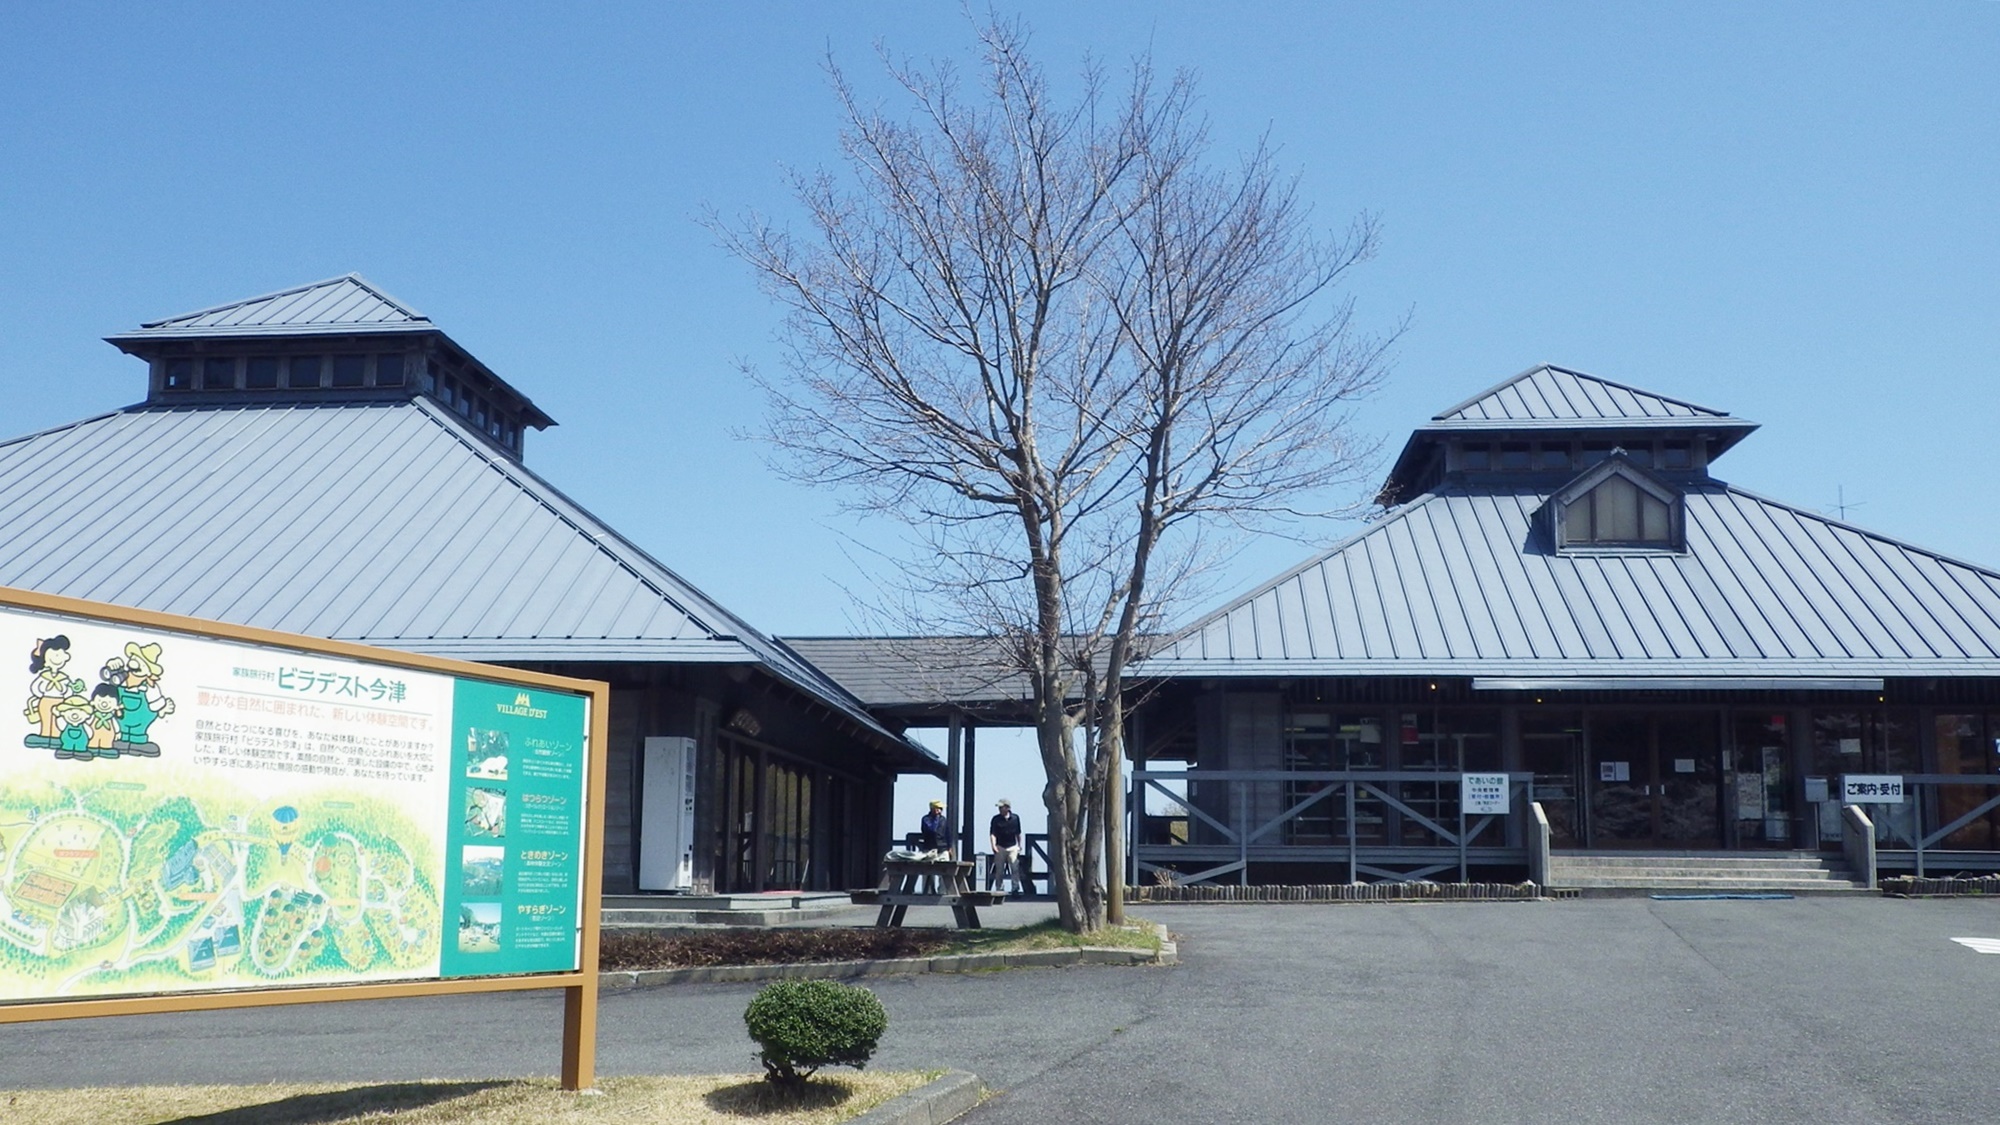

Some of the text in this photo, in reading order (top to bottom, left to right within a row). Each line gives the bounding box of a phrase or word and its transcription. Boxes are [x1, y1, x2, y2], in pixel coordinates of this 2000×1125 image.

[278, 666, 407, 703] ビラデスト今津
[197, 691, 433, 732] 豊かな自然に囲まれた、新しい体験空間です。
[497, 704, 548, 719] VILLAGE D'EST
[525, 737, 572, 751] ふれあいゾーン
[1847, 783, 1901, 795] ご案内・受付
[522, 793, 567, 805] はつらつゾーン
[520, 850, 568, 861] ときめきゾーン
[518, 904, 566, 915] やすらぎゾーン
